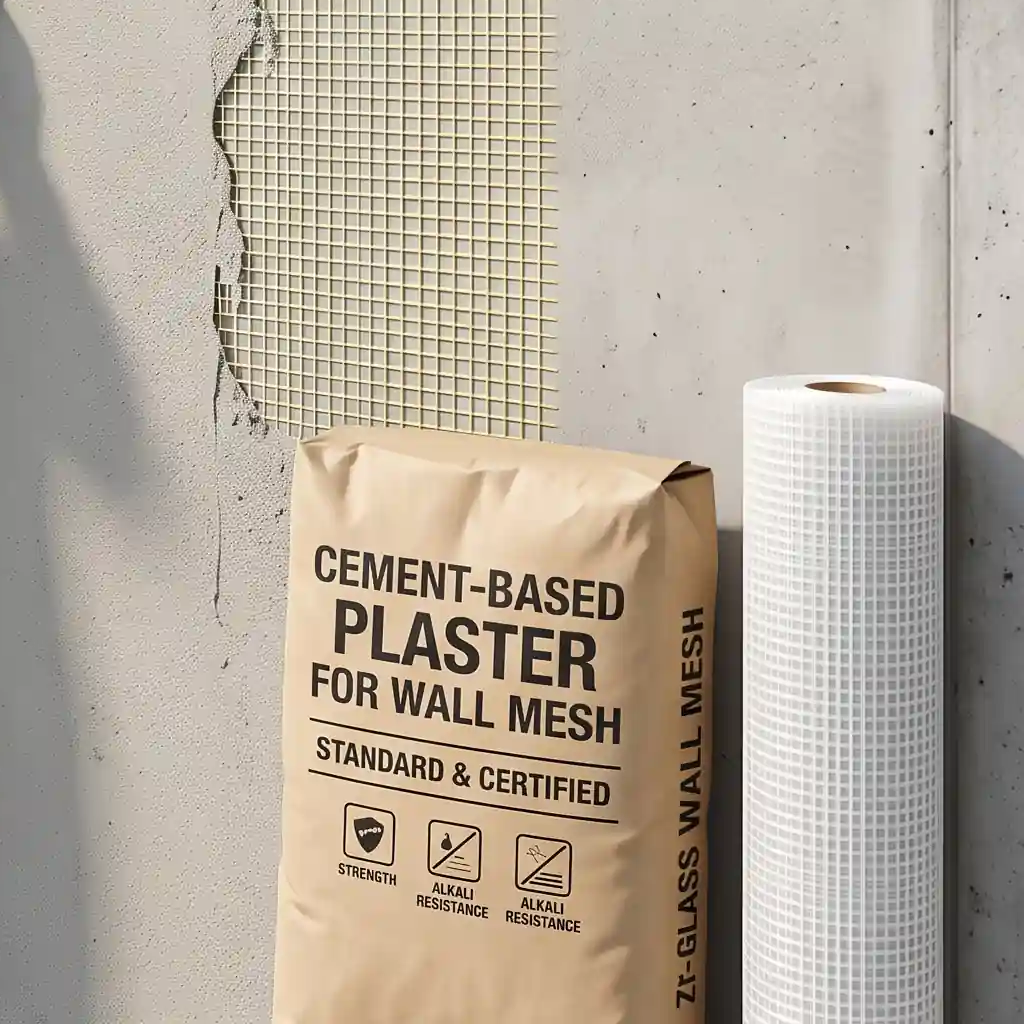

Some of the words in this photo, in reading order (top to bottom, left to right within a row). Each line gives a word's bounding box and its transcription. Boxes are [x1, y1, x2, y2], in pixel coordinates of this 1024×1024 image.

[314, 545, 625, 621] CEMENT-BASED
[334, 598, 597, 692] PLASTER
[681, 607, 704, 717] MESH
[311, 661, 379, 710] FOR
[391, 676, 495, 729] WALL
[508, 694, 622, 745] MESH
[316, 736, 444, 782] STANDARD
[452, 762, 471, 788] &
[479, 766, 611, 807] CERTIFIED
[680, 725, 702, 837] WALL
[338, 862, 397, 886] STRENGTH
[416, 894, 489, 919] RESISTANCE
[431, 882, 474, 901] ALKALI
[520, 896, 564, 915] ALKALI
[505, 910, 581, 934] RESISTANCE
[677, 845, 700, 1009] Zr-GLASS
